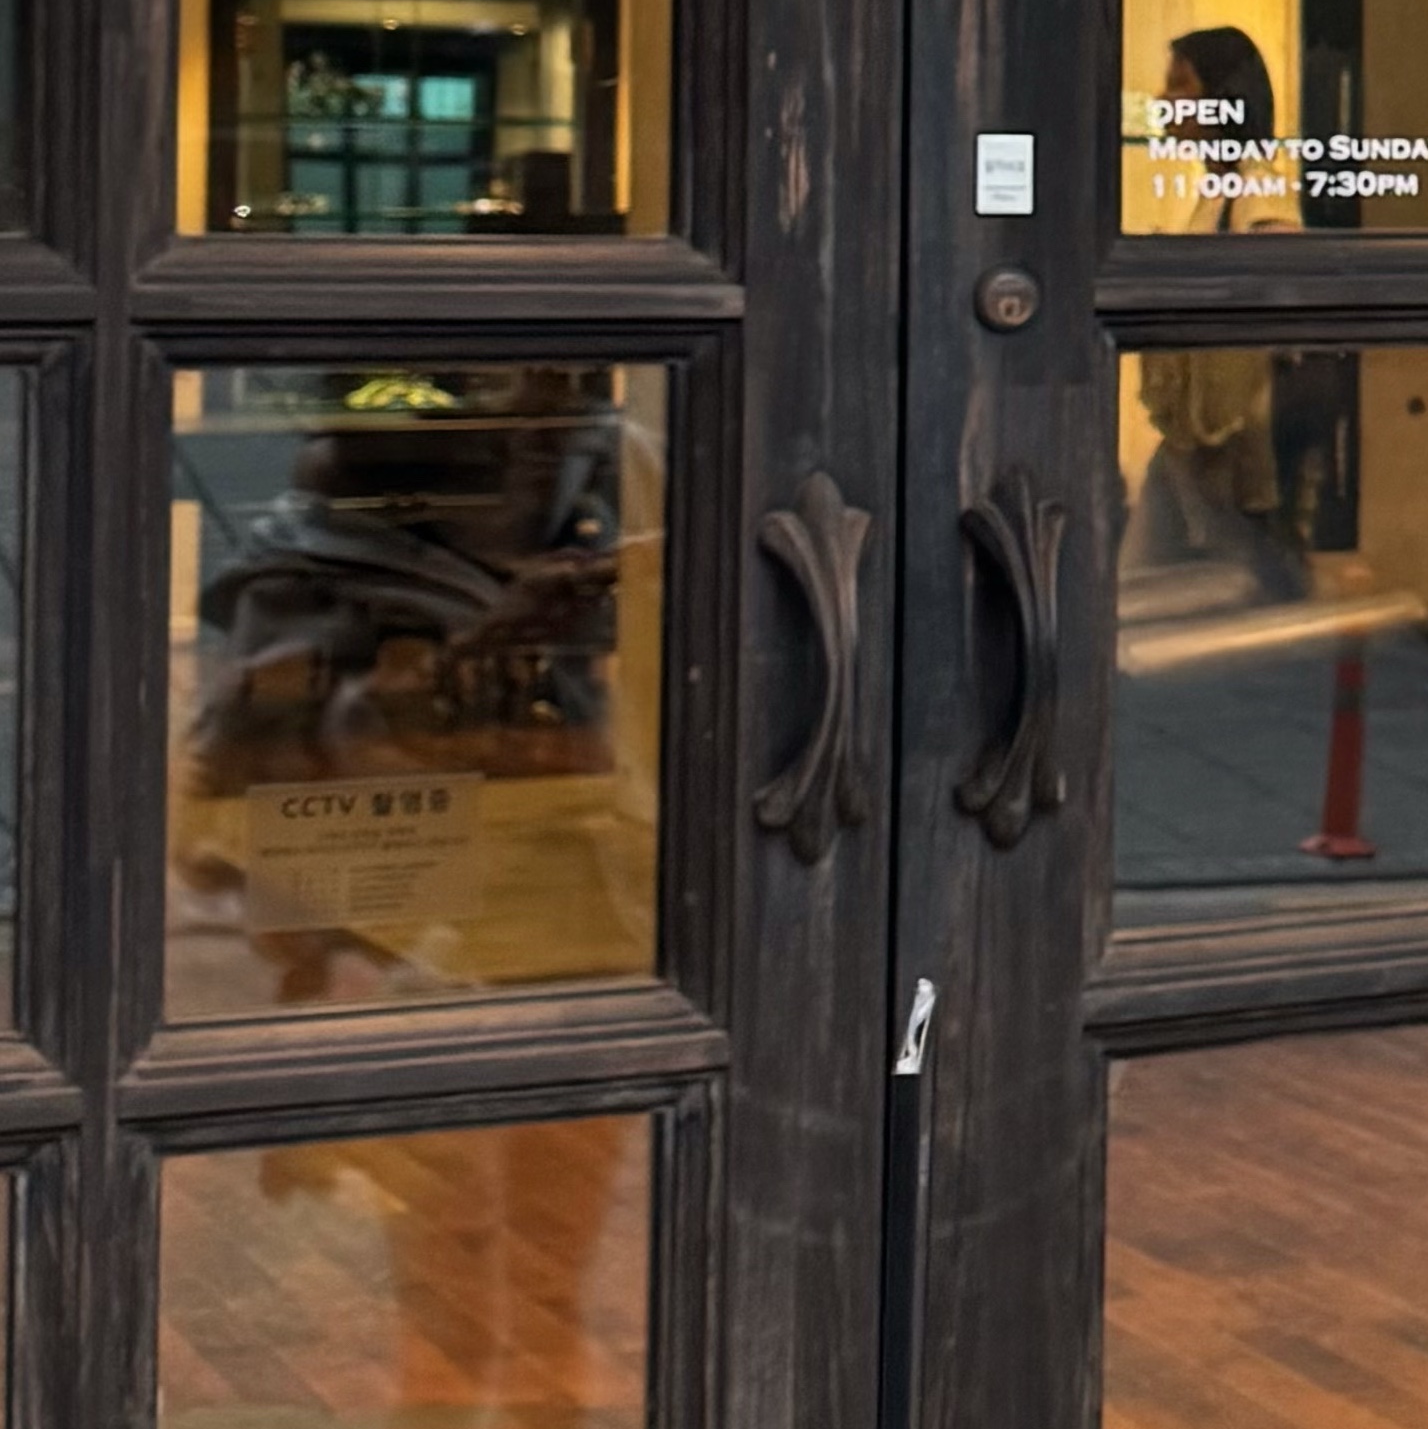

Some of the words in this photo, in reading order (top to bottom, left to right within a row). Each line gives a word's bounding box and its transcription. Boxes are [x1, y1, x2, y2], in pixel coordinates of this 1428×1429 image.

[1148, 98, 1245, 125] OPEN
[1149, 136, 1280, 162] MONDAY
[1285, 138, 1324, 161] TO
[1306, 170, 1418, 198] 7:30PM
[281, 793, 357, 819] CCTV
